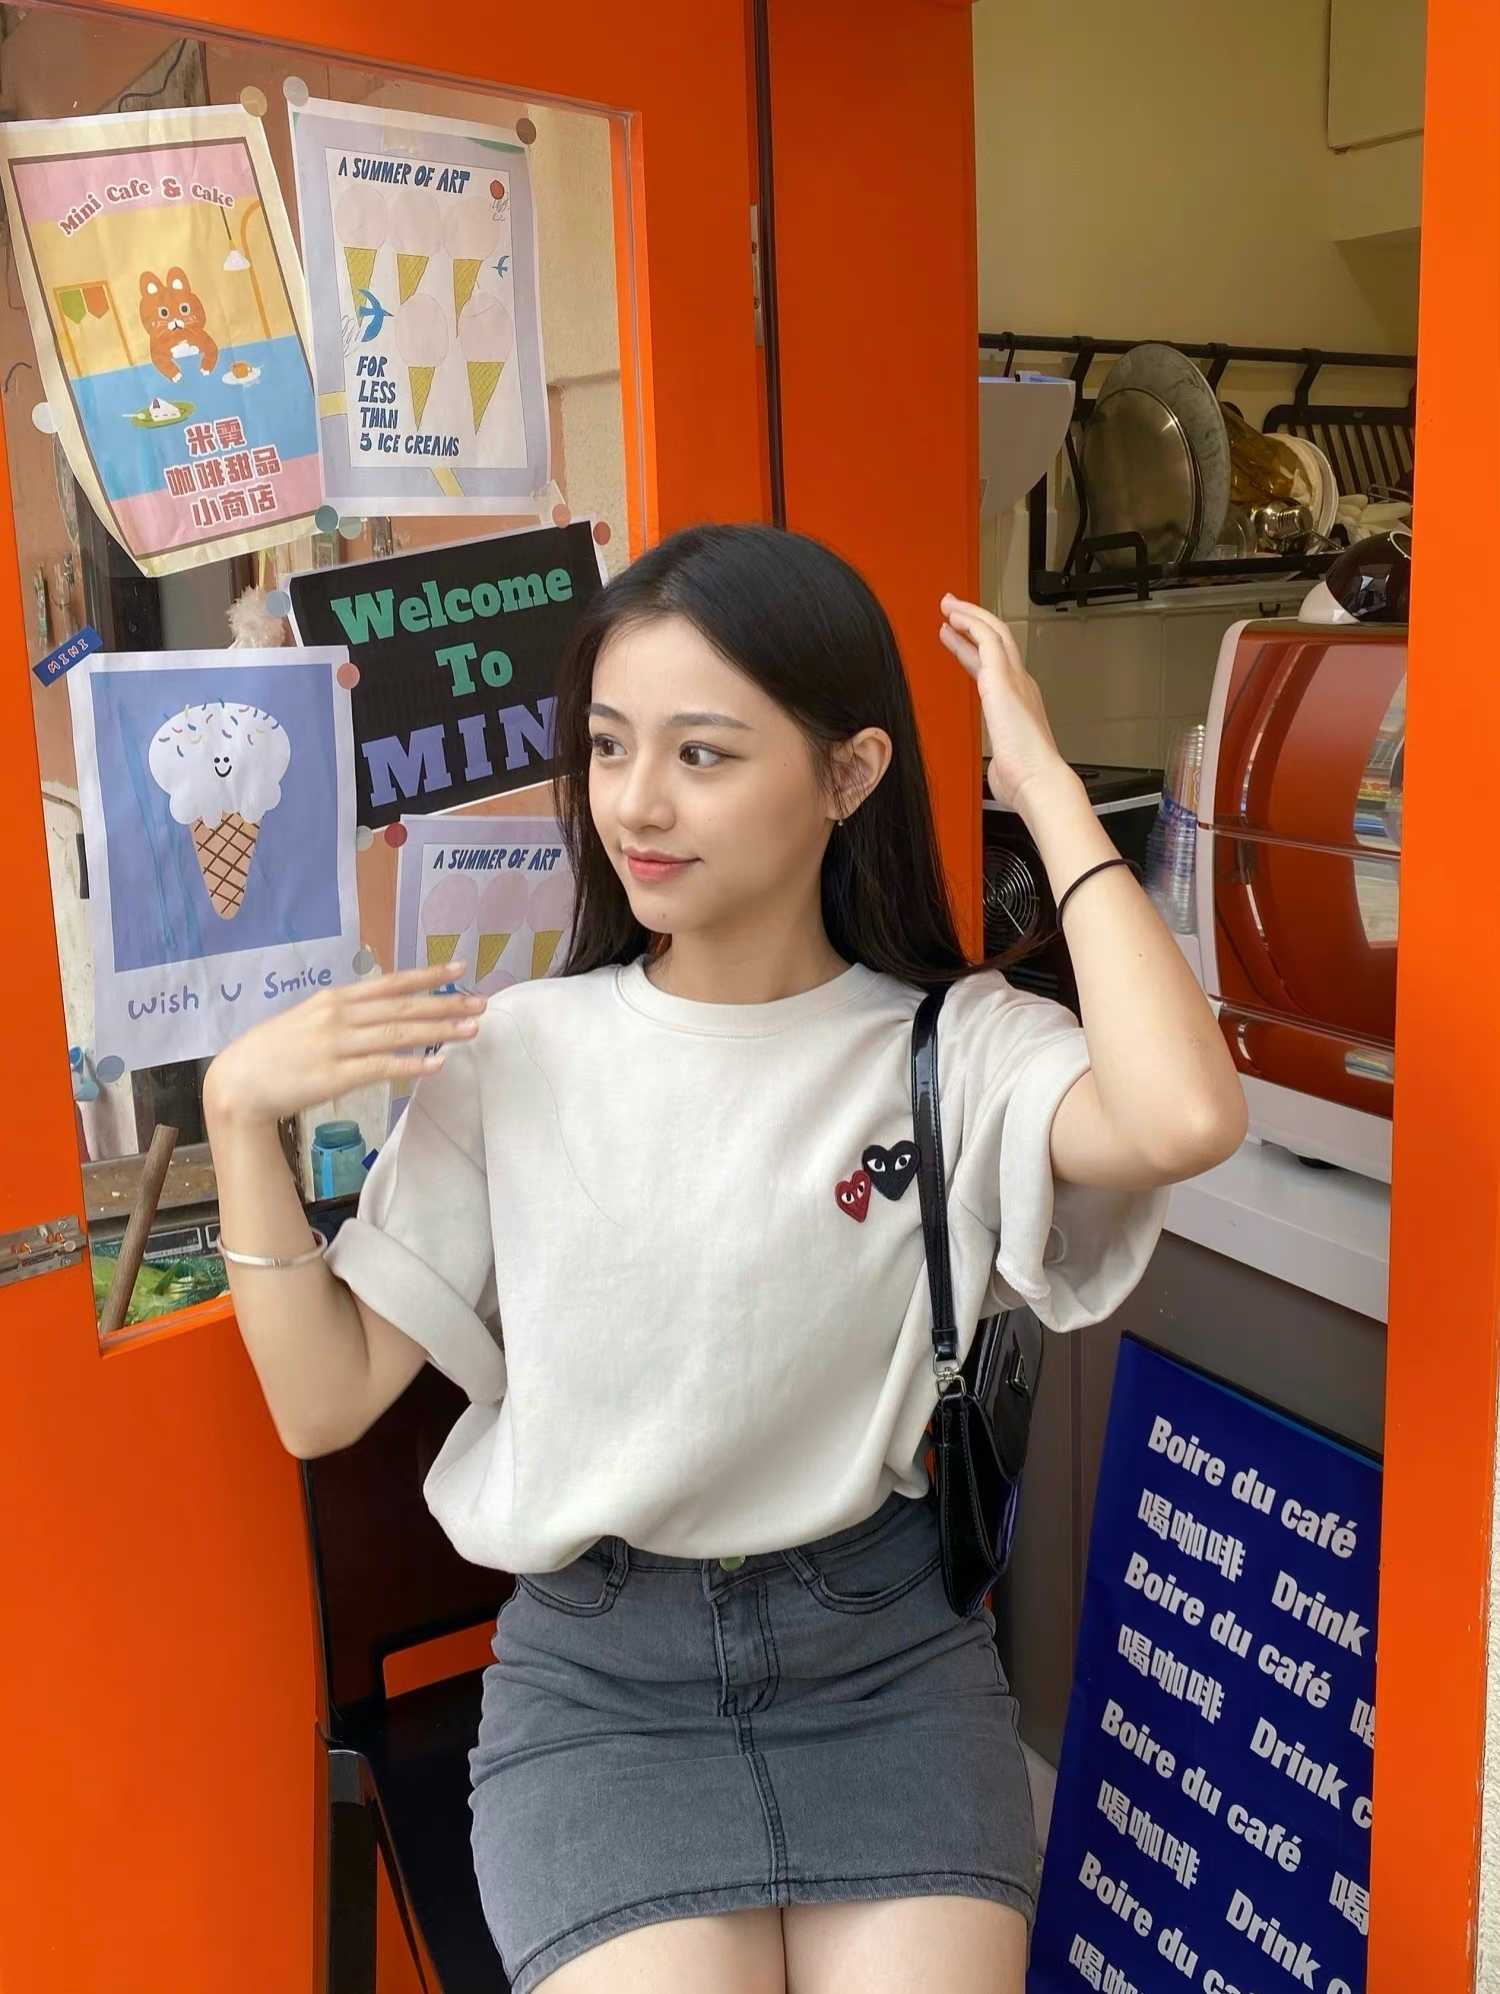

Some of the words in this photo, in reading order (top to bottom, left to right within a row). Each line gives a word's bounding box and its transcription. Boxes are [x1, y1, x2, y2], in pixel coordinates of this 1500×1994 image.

[337, 157, 347, 176] A
[352, 158, 412, 185] SUMMER
[414, 165, 435, 187] OF
[436, 168, 471, 194] ART
[58, 193, 103, 236] Mini
[106, 179, 151, 203] Cafe
[162, 177, 182, 199] &
[191, 184, 234, 208] Cake
[356, 356, 388, 378] FOR
[358, 379, 396, 405] LESS
[359, 432, 373, 452] 5
[378, 433, 401, 453] ICE
[404, 435, 460, 456] CREAMS
[360, 406, 399, 429] THAN
[164, 446, 281, 498] 咖啡甜品
[191, 483, 277, 527] 小商店
[330, 568, 573, 645] Welcome
[47, 638, 89, 674] MINI
[434, 642, 513, 696] To
[361, 696, 558, 808] MIN
[433, 850, 444, 869] A
[447, 848, 507, 870] SUMMER
[507, 848, 529, 869] OF
[527, 848, 562, 871] ART
[1147, 1415, 1226, 1487] Boire
[1231, 1467, 1277, 1515] du
[1280, 1498, 1358, 1559] café
[1137, 1488, 1247, 1583] 喝咖啡
[1271, 1570, 1370, 1657] Drink
[1124, 1551, 1205, 1626] Boire
[1209, 1610, 1253, 1659] du
[1258, 1643, 1332, 1709] café
[1117, 1623, 1225, 1725] 喝咖啡
[1249, 1716, 1349, 1810] Drink
[1100, 1698, 1177, 1779] Boire
[1181, 1766, 1223, 1816] du
[1226, 1804, 1302, 1873] café
[1096, 1779, 1201, 1890] 喝咖啡
[1225, 1888, 1321, 1991] Drink
[1078, 1851, 1153, 1937] Boire
[1157, 1927, 1199, 1979] du
